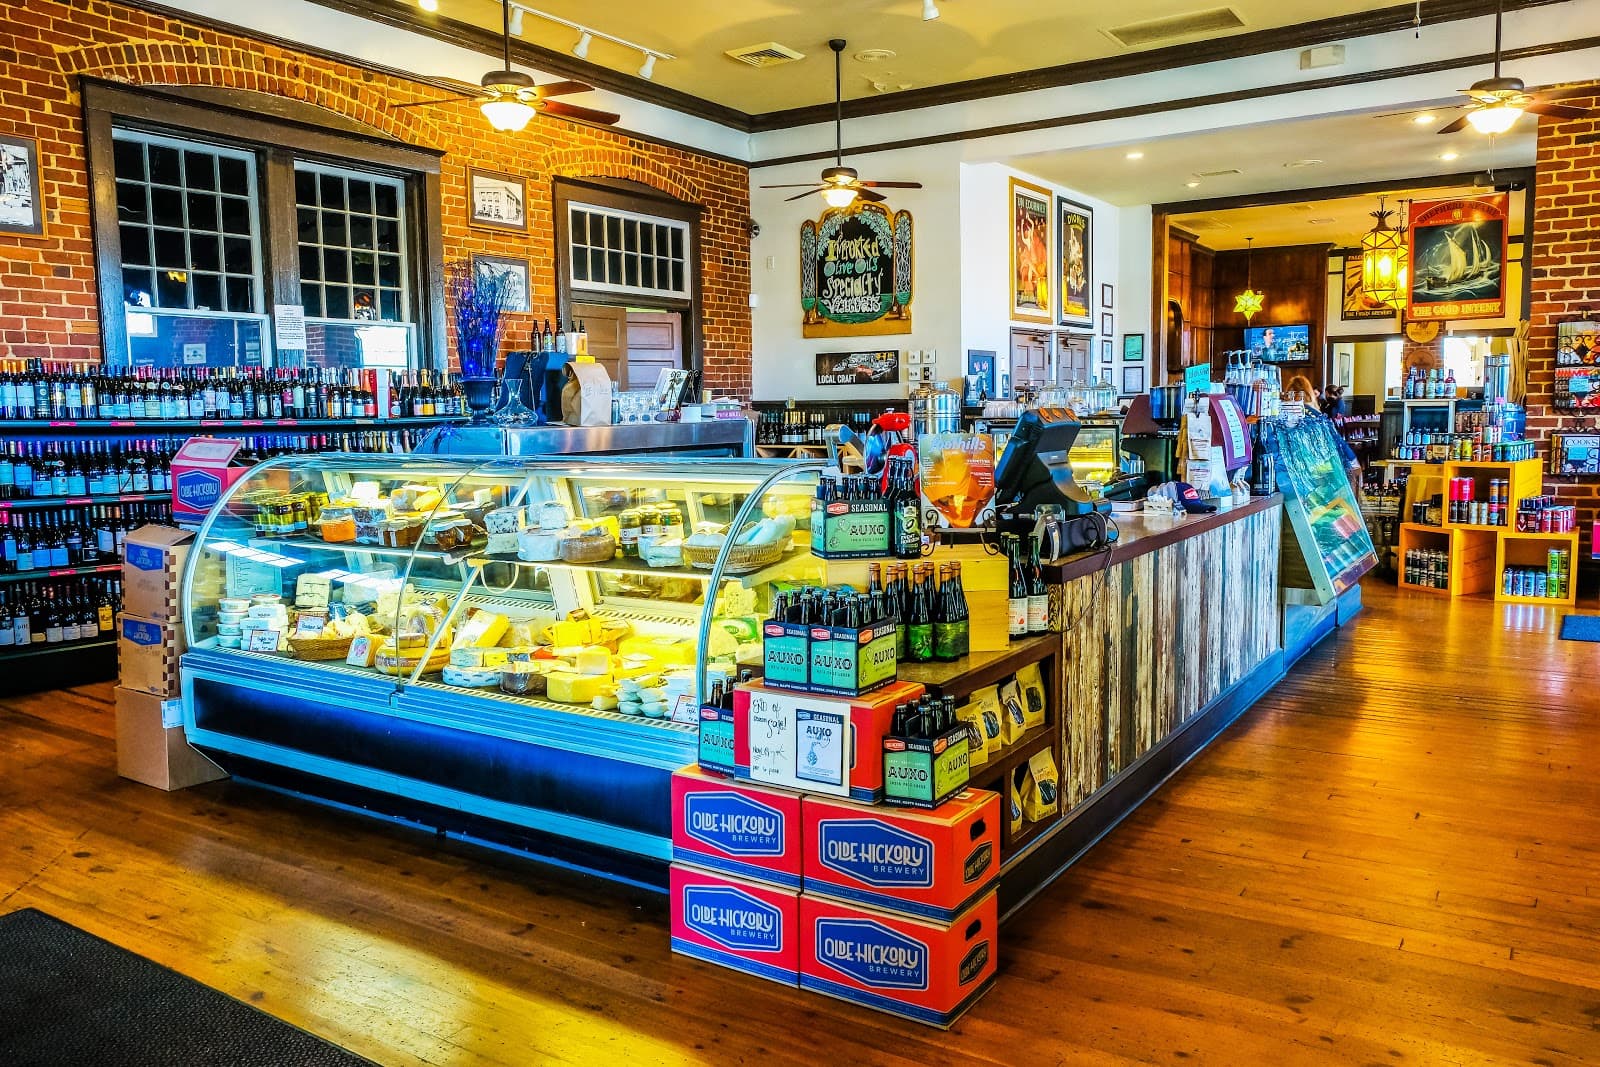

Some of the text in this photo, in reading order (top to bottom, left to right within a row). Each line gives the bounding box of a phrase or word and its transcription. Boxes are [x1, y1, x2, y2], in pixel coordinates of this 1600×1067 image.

[1412, 302, 1501, 317] THE GOOD INTENT
[818, 374, 857, 384] LOCAL CRAFT
[851, 504, 888, 513] SEASONAL
[850, 524, 886, 536] AUXO
[786, 628, 807, 637] SEASONAL
[834, 632, 856, 641] SEASONAL
[874, 623, 896, 638] SEASONAL
[768, 650, 804, 666] AUXO
[814, 655, 852, 670] AUXO
[873, 647, 895, 666] AUXO
[813, 713, 840, 725] SEASONAL
[806, 725, 832, 737] AUXO
[948, 727, 968, 746] SEASONAL
[908, 743, 931, 752] SEASONAL
[948, 752, 968, 774] AUXO
[888, 766, 928, 782] AUXO
[692, 811, 776, 836] OLDE HICKORY
[732, 834, 777, 844] BREWERY
[828, 840, 924, 867] OLDE HICKORY
[873, 865, 925, 876] BREWERY
[691, 904, 773, 932] OLDE HICKORY
[730, 928, 775, 940] BREWERY
[824, 938, 919, 969] OLDE HICKORY
[869, 965, 920, 978] BREWERY
